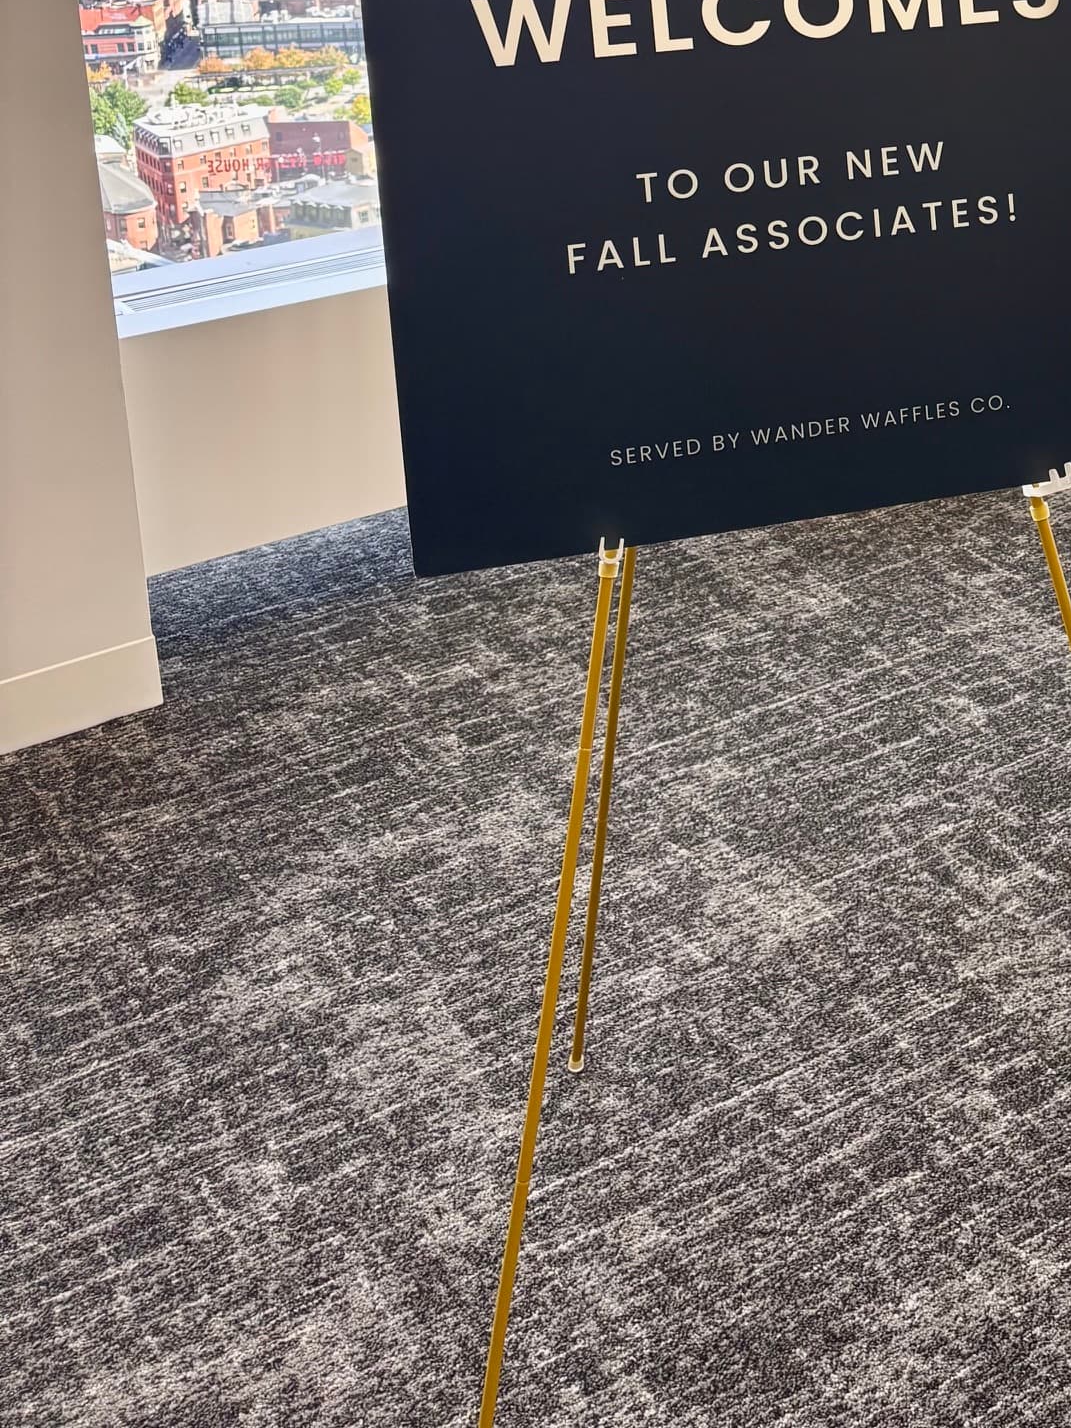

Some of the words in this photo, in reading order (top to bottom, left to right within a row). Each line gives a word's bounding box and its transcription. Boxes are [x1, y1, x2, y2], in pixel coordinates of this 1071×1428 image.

[635, 168, 699, 203] TO
[724, 155, 822, 193] OUR
[846, 141, 944, 180] NEW
[567, 233, 677, 275] FALL
[702, 193, 1017, 259] ASSOCIATES!
[610, 438, 701, 466] SERVED
[712, 432, 740, 452] BY
[750, 415, 850, 445] WANDER
[860, 400, 960, 429] WAFFLES
[970, 395, 1011, 413] CO.
